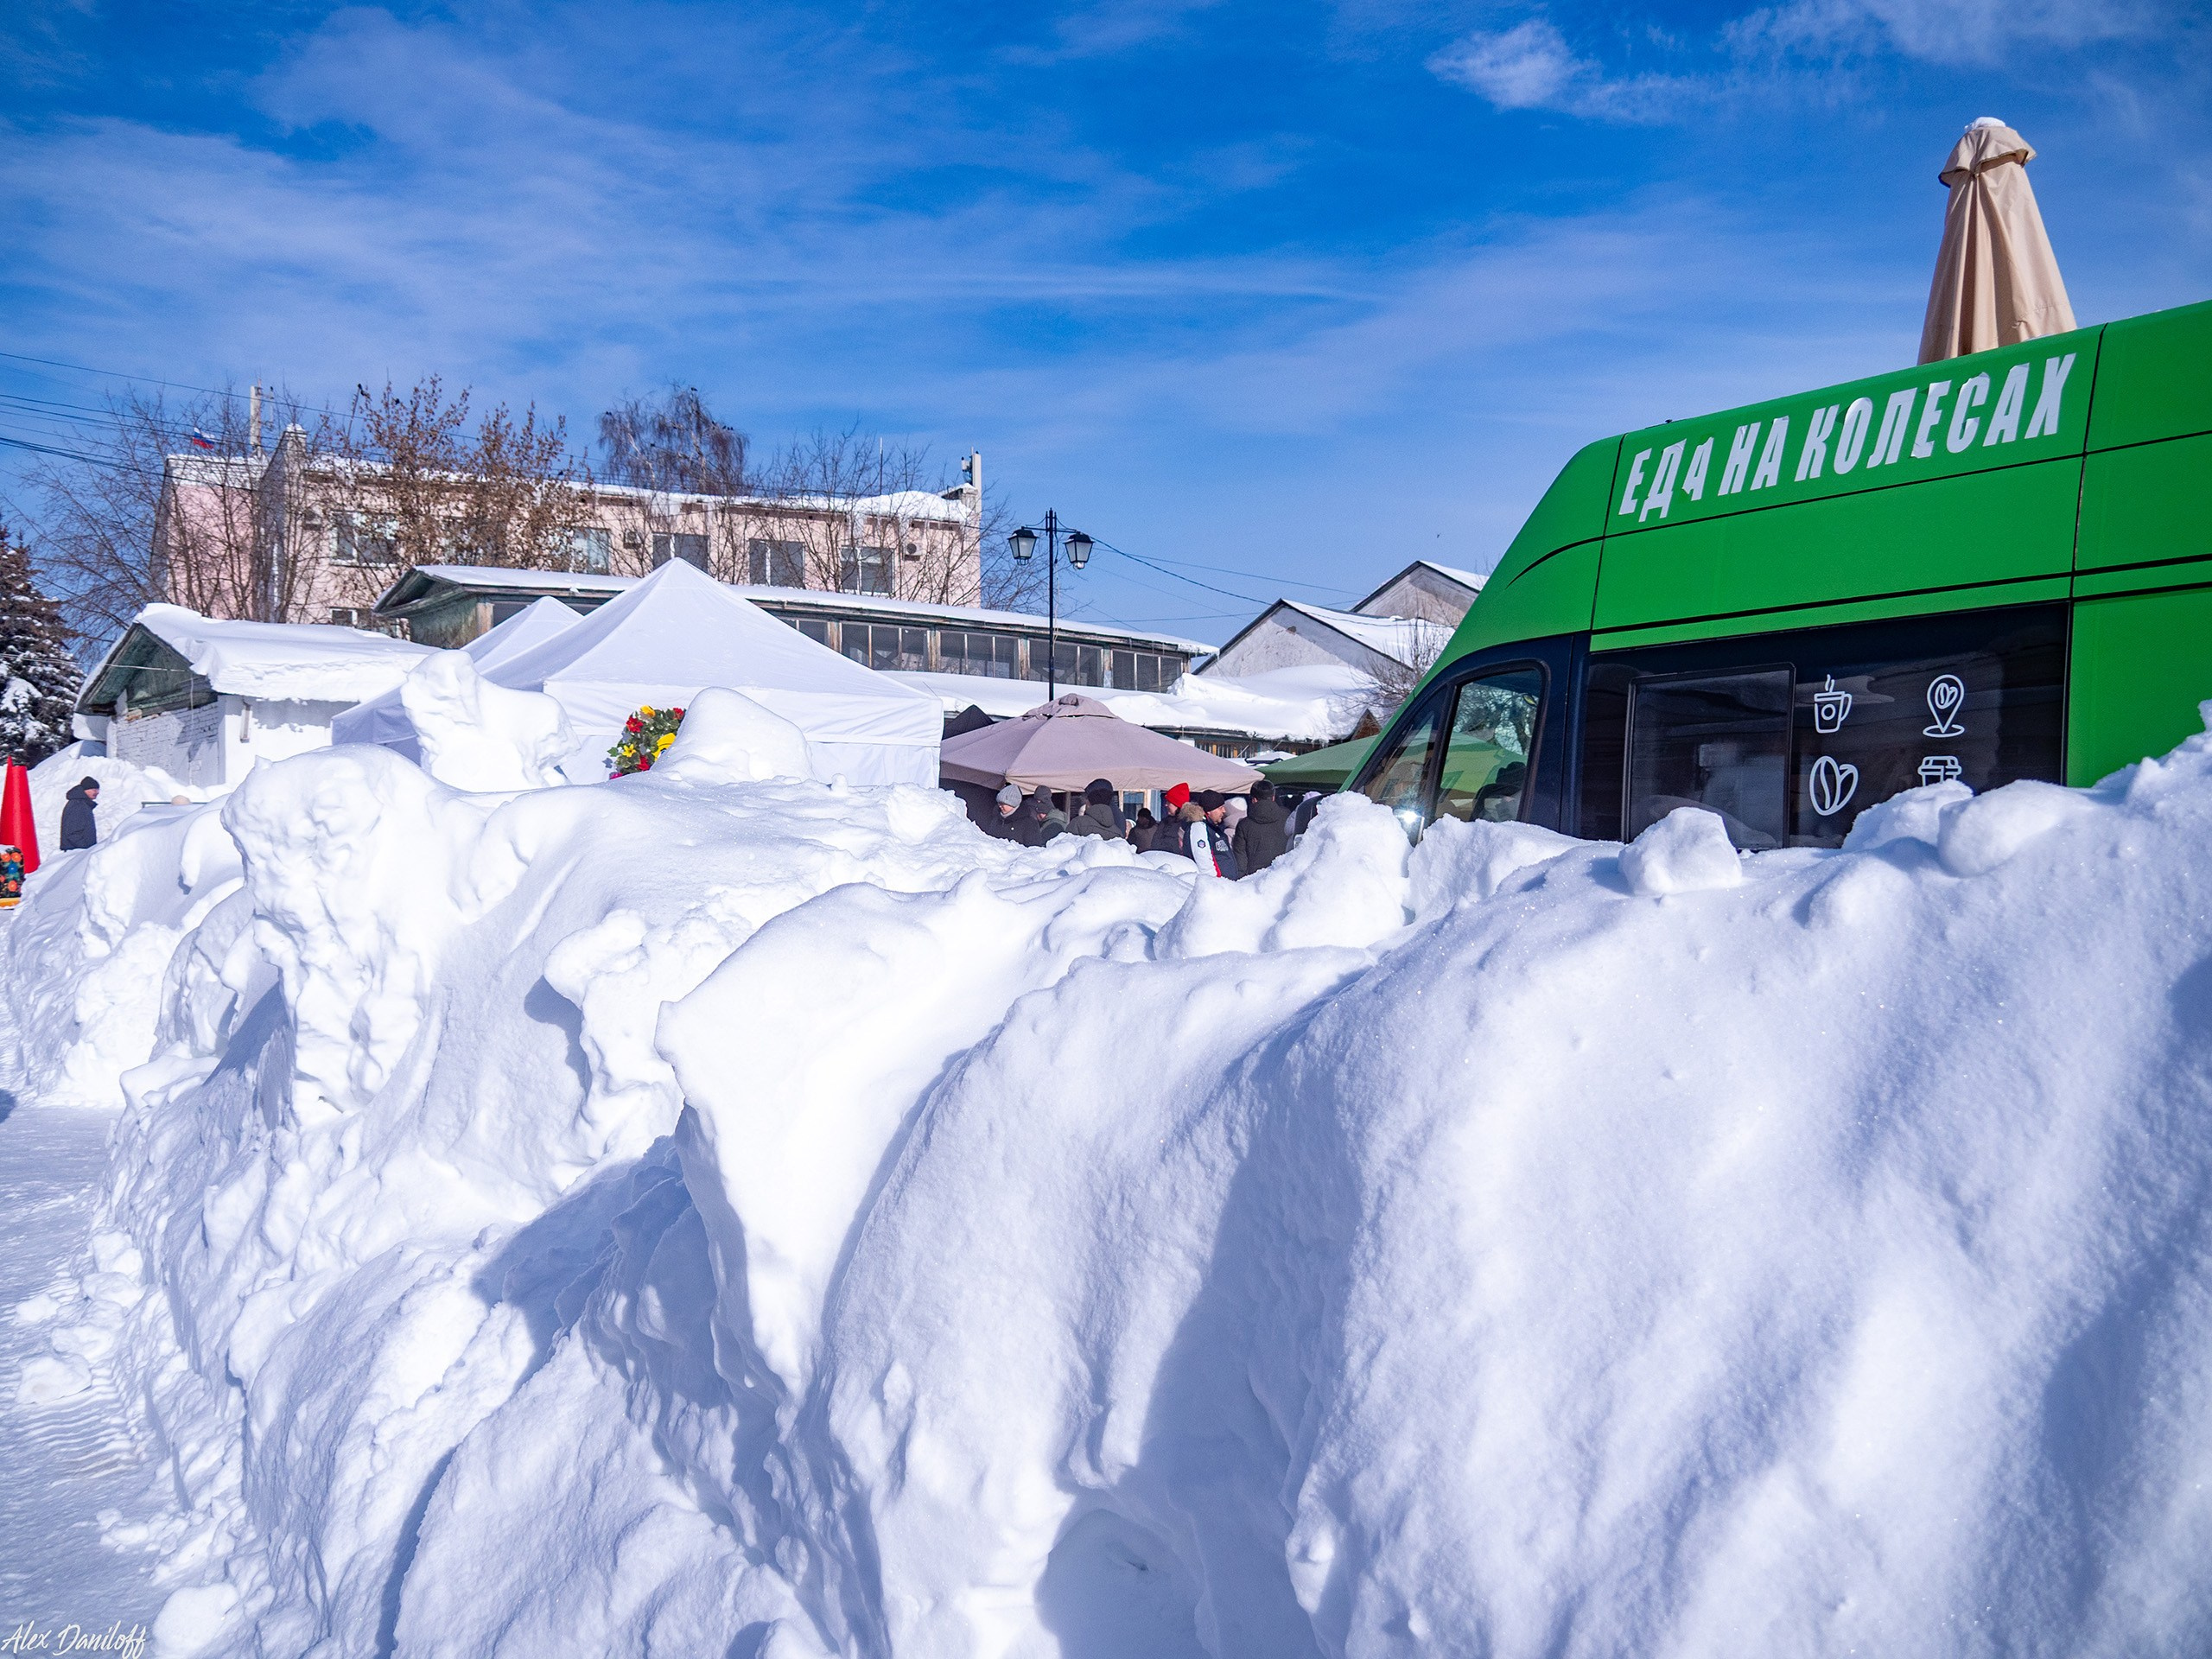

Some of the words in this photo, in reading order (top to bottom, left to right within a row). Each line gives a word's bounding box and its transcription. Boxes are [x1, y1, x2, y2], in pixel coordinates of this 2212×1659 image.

[1618, 436, 1713, 522] ЕДА
[1718, 416, 1789, 496] НА
[1795, 353, 2075, 481] КОЛЕСАХ
